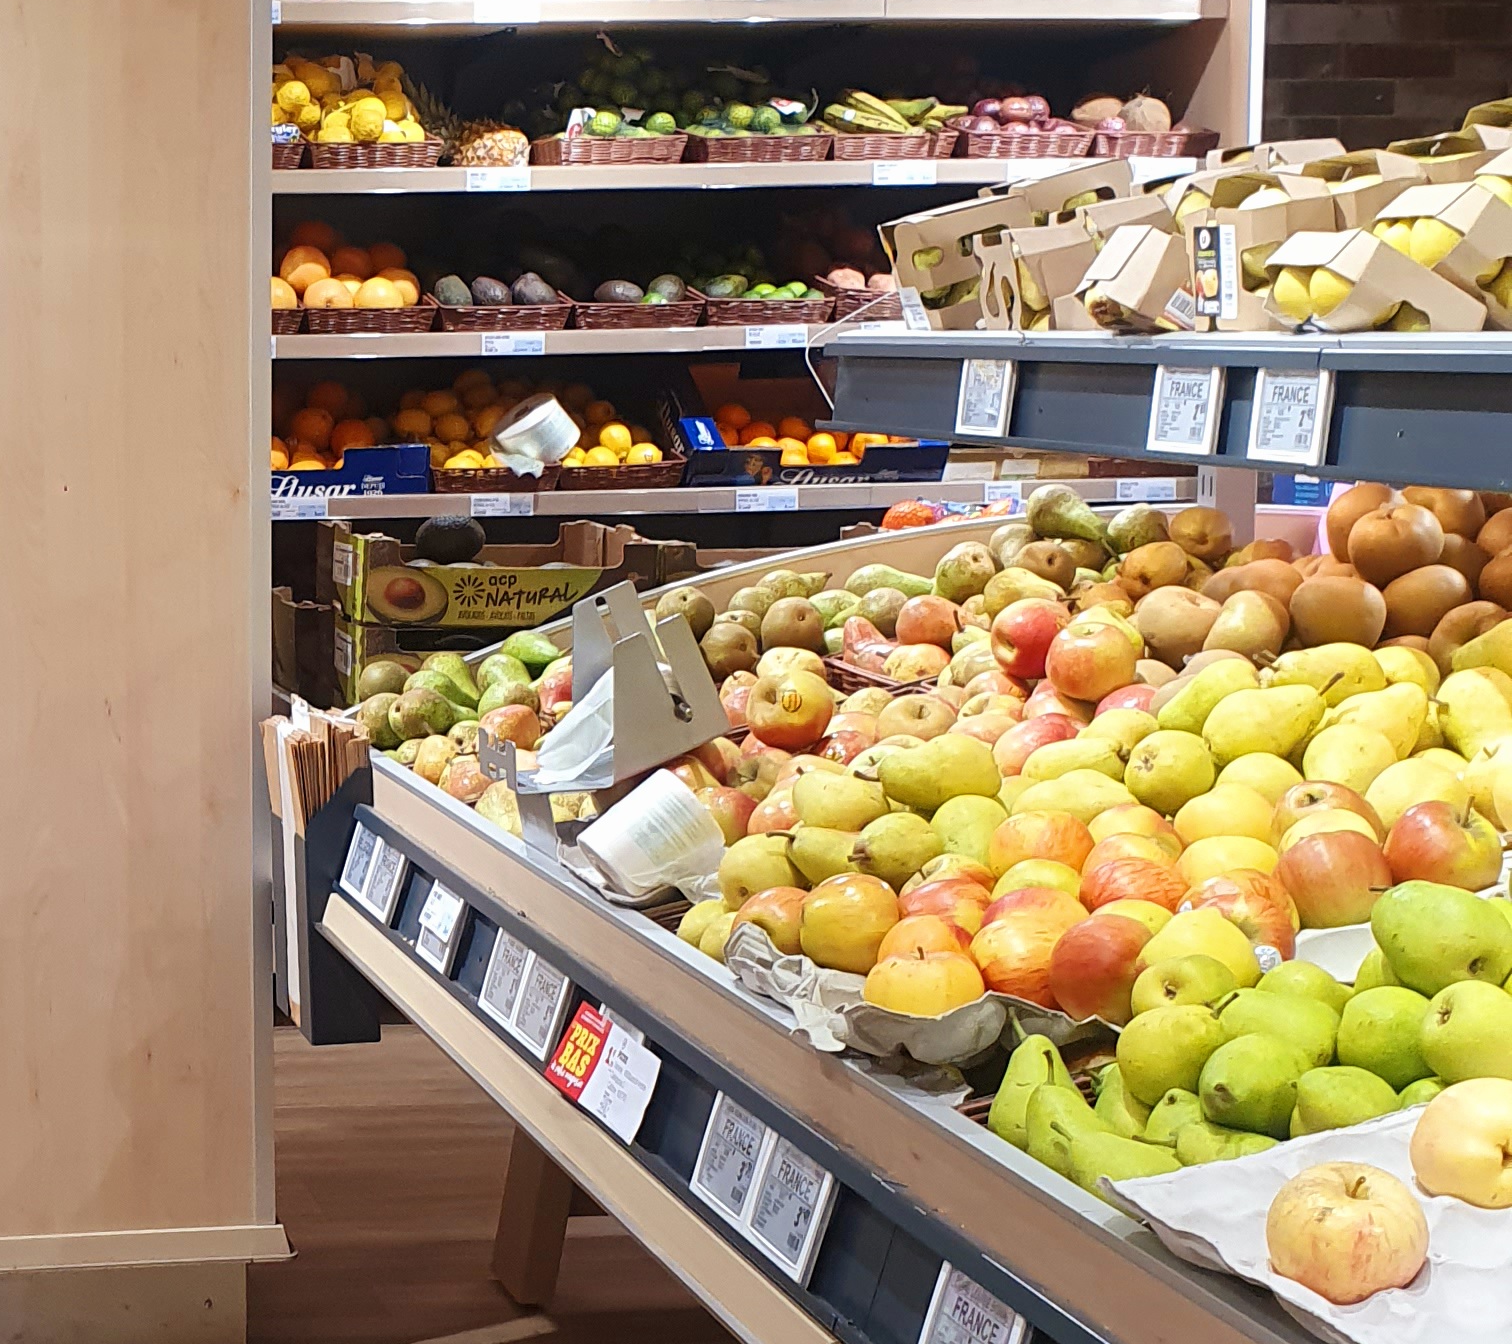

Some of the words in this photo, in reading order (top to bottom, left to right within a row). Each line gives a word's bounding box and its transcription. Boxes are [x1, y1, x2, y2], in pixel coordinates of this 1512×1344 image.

[1169, 380, 1204, 399] FRANCE
[1271, 385, 1311, 404] FRANCE
[485, 582, 579, 610] NATURAL
[569, 1024, 601, 1057] PRIX
[558, 1041, 591, 1078] BAS
[722, 1118, 756, 1156] FRANCE
[777, 1159, 815, 1201] FRANCE
